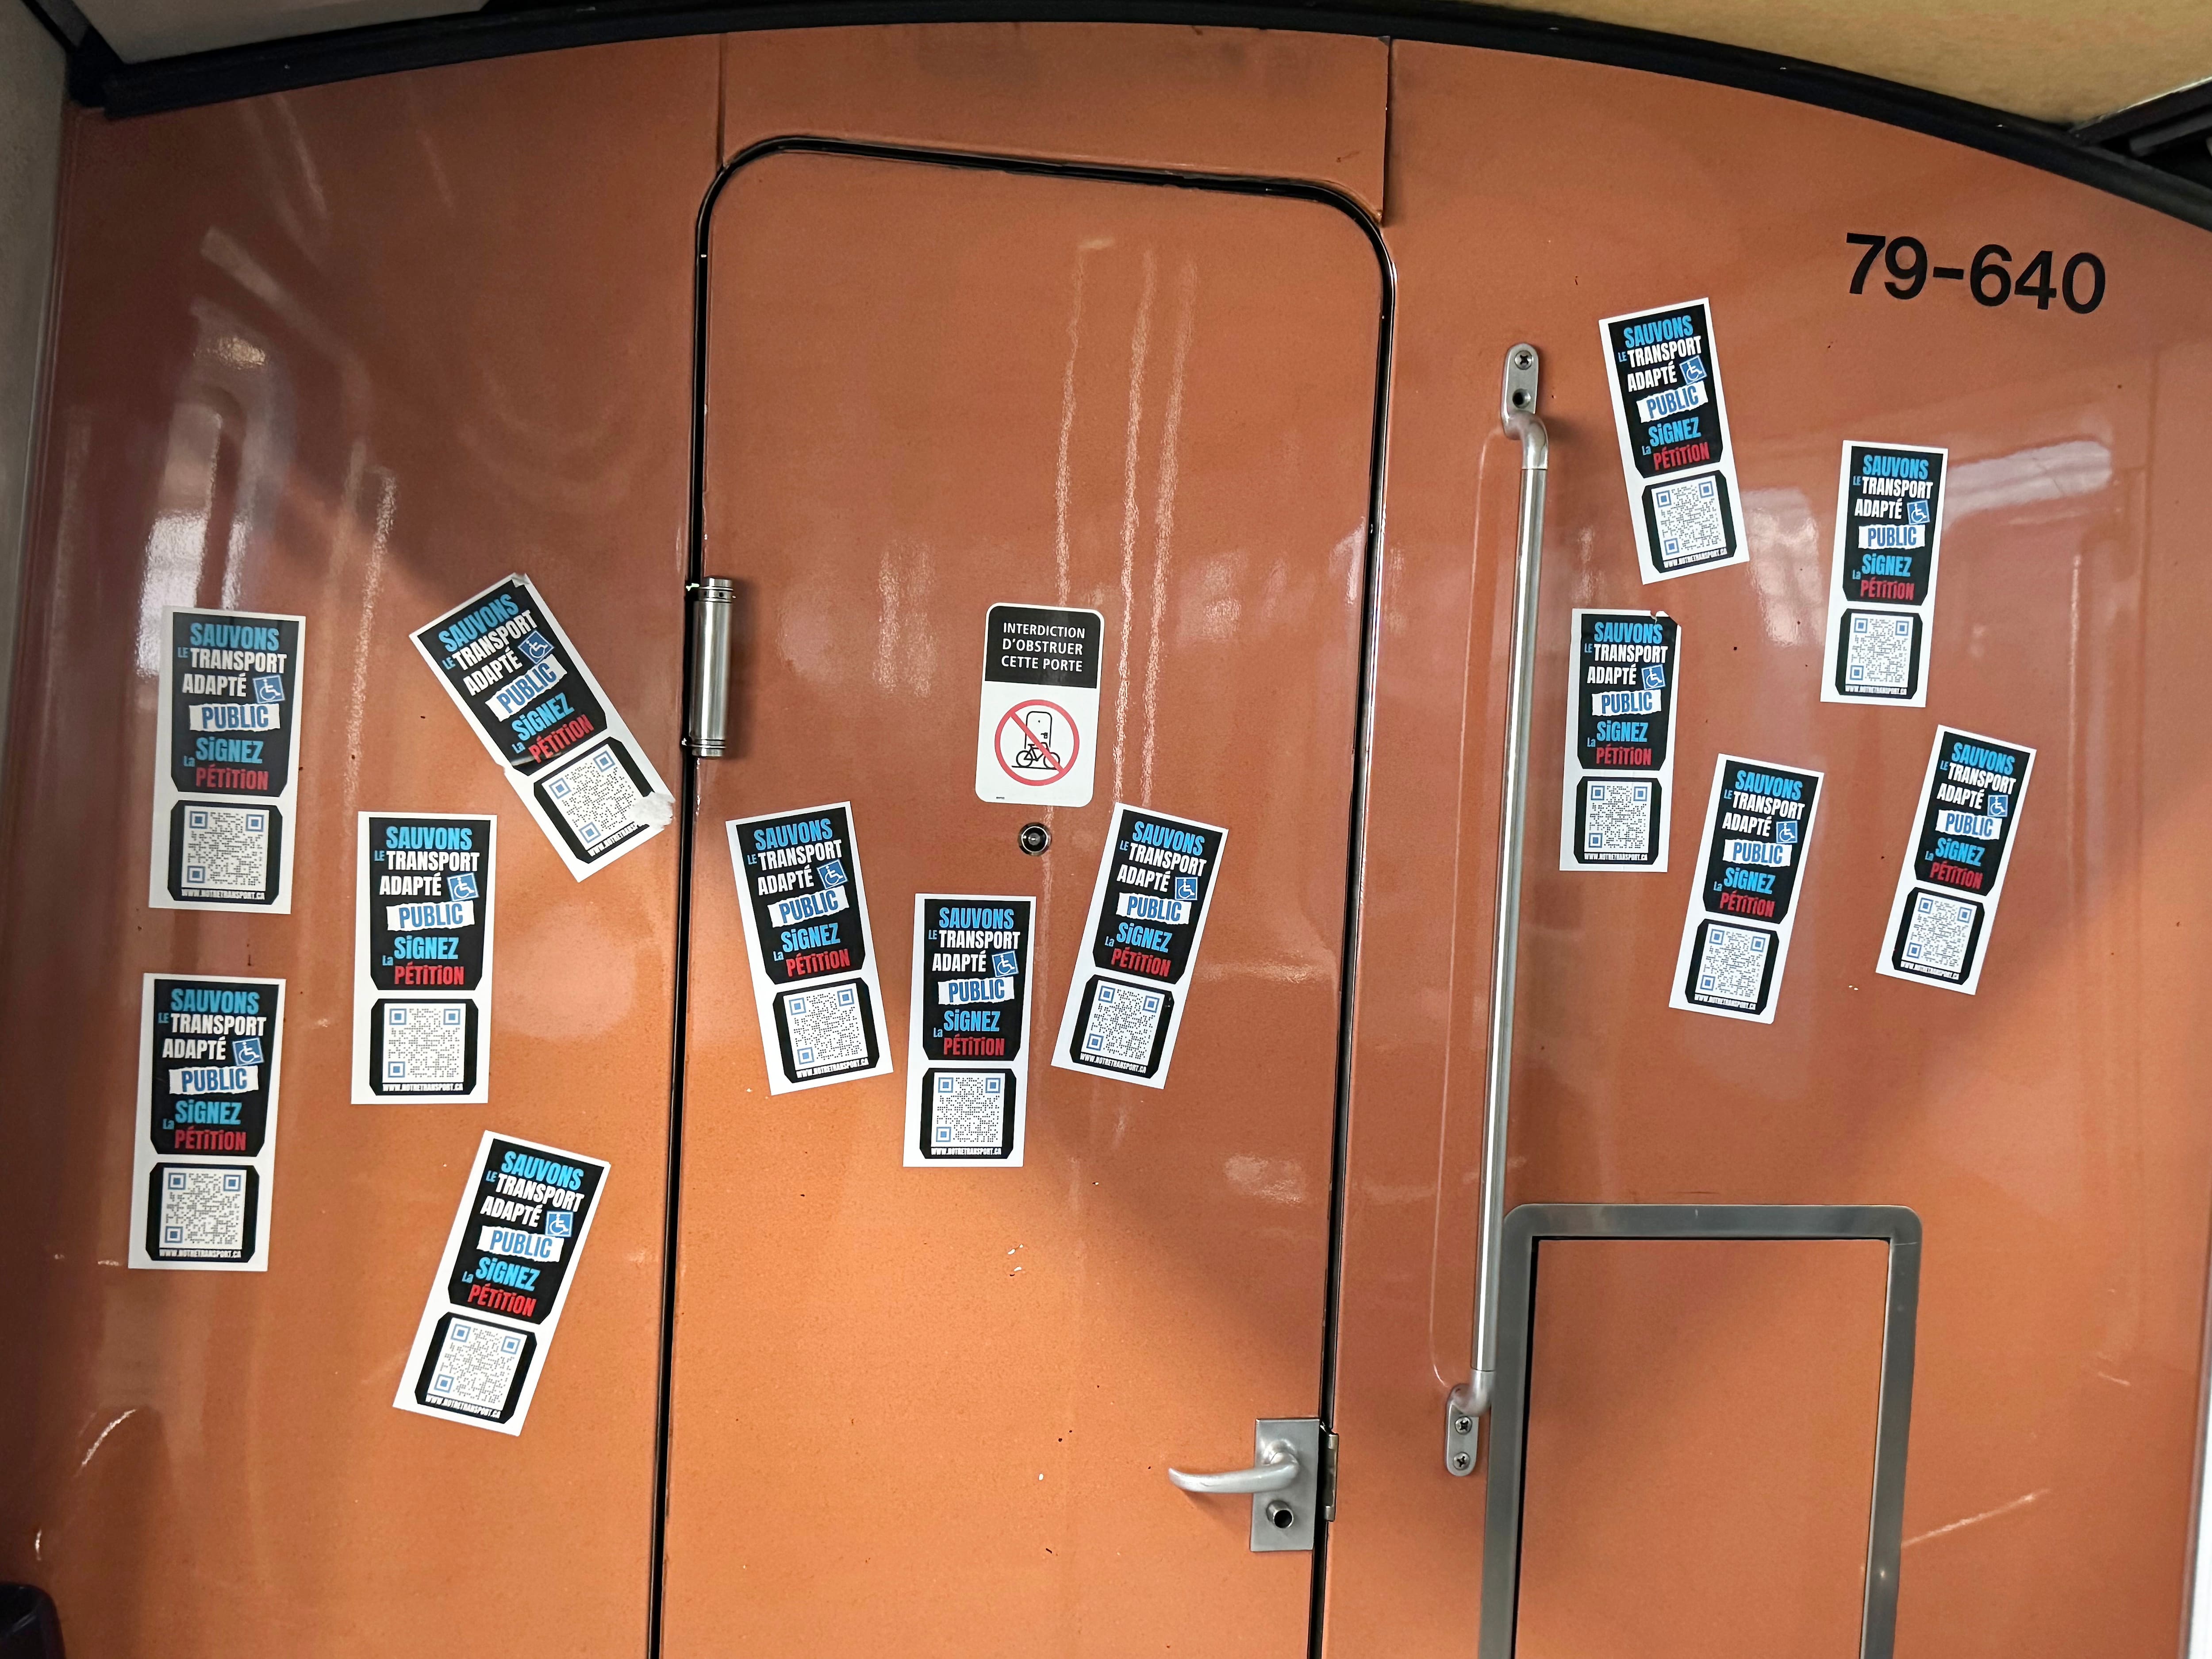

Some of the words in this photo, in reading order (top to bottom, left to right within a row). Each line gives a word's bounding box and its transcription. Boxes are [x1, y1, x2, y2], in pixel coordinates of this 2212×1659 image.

[1847, 232, 2105, 314] 79-640
[1624, 315, 1692, 347] SAUVONS
[1618, 352, 1626, 361] LE
[1627, 336, 1701, 367] TRANSPORT
[1628, 361, 1676, 391] ADAPTÉ
[1647, 386, 1698, 418] PUBLIC
[1863, 455, 1928, 479] SAUVONS
[1853, 476, 1860, 485] LE
[1863, 477, 1932, 498] TRANSPORT
[1855, 498, 1902, 518] ADAPTÉ
[1869, 527, 1916, 546] PUBLIC
[439, 594, 518, 651] SAUVONS
[1003, 622, 1085, 638] INTERDICTION
[1594, 622, 1661, 643] SAUVONS
[191, 623, 279, 650] SAUVONS
[443, 657, 455, 669] LE
[452, 610, 537, 669] TRANSPORT
[1002, 638, 1083, 655] D'OBSTRUER
[178, 647, 187, 657] LE
[191, 648, 286, 672] TRANSPORT
[1001, 656, 1038, 669] CETTE
[1043, 658, 1083, 672] PORTE
[1585, 644, 1591, 652] LE
[1594, 644, 1667, 662] TRANSPORT
[464, 647, 522, 695] ADAPTÉ
[1587, 664, 1636, 684] ADAPTÉ
[183, 672, 246, 696] ADAPTÉ
[497, 664, 555, 713] PUBLIC
[1602, 692, 1651, 713] PUBLIC
[202, 706, 267, 728] PUBLIC
[1952, 743, 2014, 774] SAUVONS
[1736, 771, 1801, 799] SAUVONS
[1940, 761, 1948, 770] LE
[1948, 763, 2016, 794] TRANSPORT
[1724, 790, 1732, 799] LE
[1733, 791, 1804, 819] TRANSPORT
[1937, 783, 1984, 808] ADAPTÉ
[754, 818, 832, 850] SAUVONS
[1722, 813, 1771, 836] ADAPTÉ
[1945, 814, 1992, 836] PUBLIC
[387, 827, 471, 849] SAUVONS
[1133, 822, 1204, 855] SAUVONS
[375, 851, 384, 860] LE
[387, 851, 479, 870] TRANSPORT
[748, 854, 757, 864] LE
[758, 840, 841, 870] TRANSPORT
[1120, 841, 1129, 850] LE
[1129, 843, 1206, 876] TRANSPORT
[1733, 843, 1782, 863] PUBLIC
[380, 872, 441, 895] ADAPTÉ
[758, 864, 813, 895] ADAPTÉ
[1117, 864, 1170, 891] ADAPTÉ
[399, 904, 462, 928] PUBLIC
[779, 891, 837, 923] PUBLIC
[940, 908, 1013, 929] SAUVONS
[1127, 896, 1181, 921] PUBLIC
[929, 930, 937, 939] LE
[939, 930, 1020, 948] TRANSPORT
[933, 950, 986, 971] ADAPTÉ
[172, 989, 258, 1014] SAUVONS
[949, 980, 1003, 1002] PUBLIC
[159, 1013, 168, 1022] LE
[171, 1014, 265, 1035] TRANSPORT
[163, 1036, 225, 1059] ADAPTÉ
[796, 1058, 868, 1078] WWW.NOTRETRANSPORT.CA
[1080, 1053, 1146, 1073] WWW.NOTRETRANSPORT.CA
[182, 1069, 246, 1091] PUBLIC
[502, 1152, 583, 1189] SAUVONS
[487, 1171, 497, 1181] LE
[496, 1174, 584, 1211] TRANSPORT
[480, 1196, 541, 1226] ADAPTÉ
[490, 1230, 552, 1257] PUBLIC
